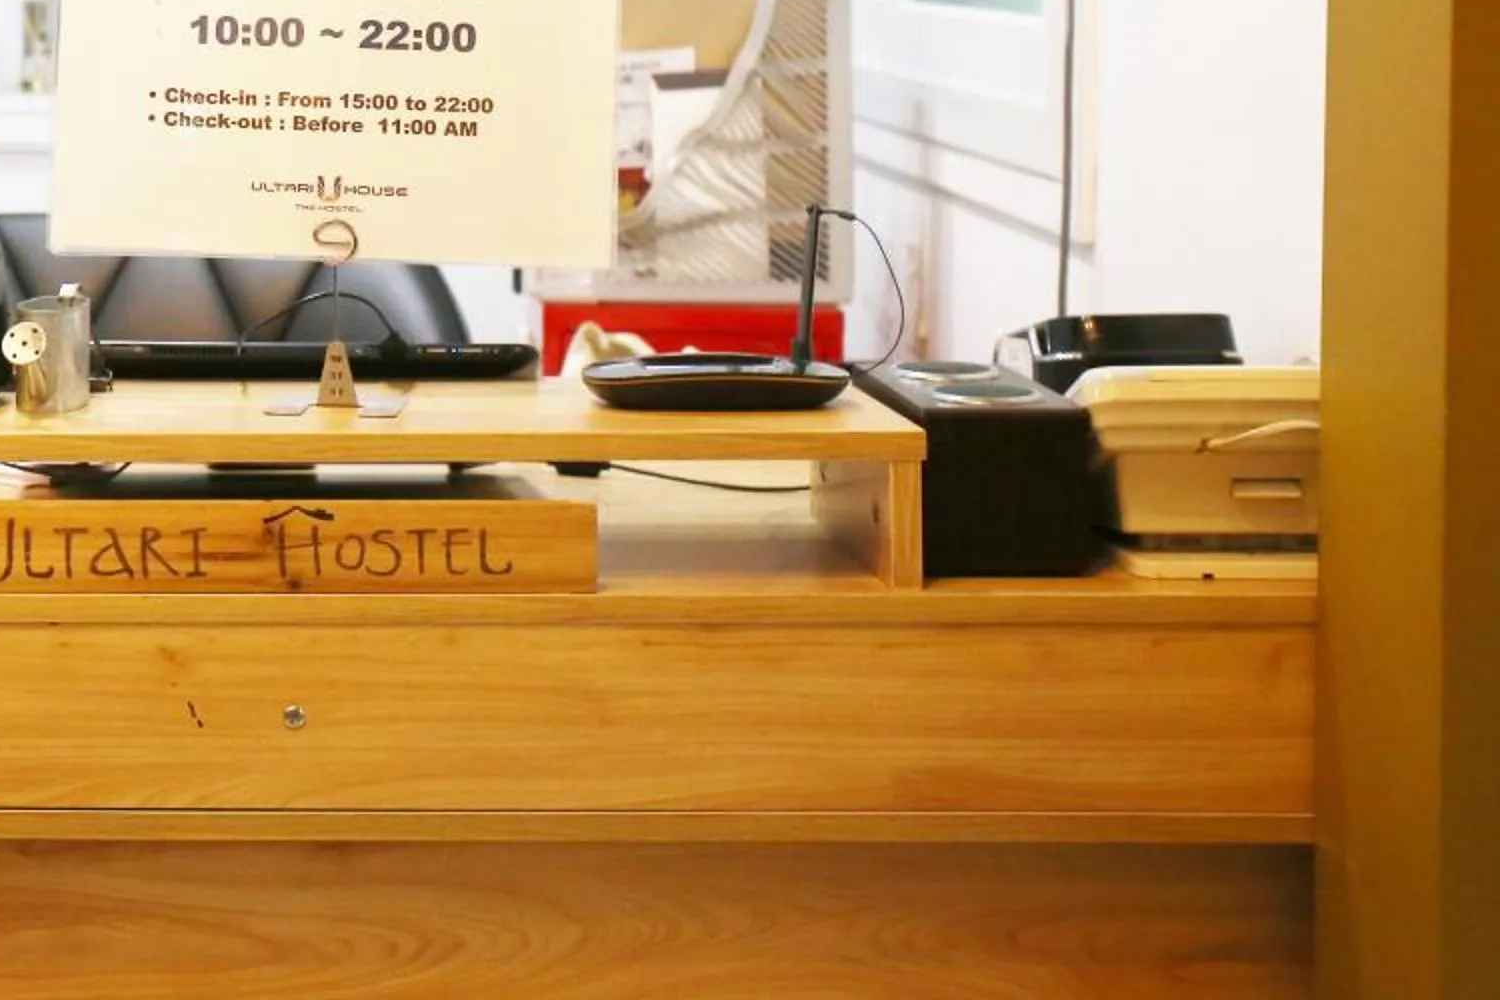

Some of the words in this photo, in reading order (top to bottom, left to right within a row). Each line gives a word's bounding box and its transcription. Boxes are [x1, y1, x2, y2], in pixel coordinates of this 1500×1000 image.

[190, 15, 305, 48] 10:00
[319, 27, 344, 39] ~
[359, 19, 477, 53] 22:00
[164, 88, 257, 106] Check-in
[278, 92, 332, 109] From
[340, 94, 399, 111] 15:00
[405, 95, 427, 111] to
[434, 97, 494, 114] 22:00
[163, 111, 273, 130] Check-out
[293, 116, 364, 133] Before
[377, 119, 437, 135] 11:00
[443, 121, 478, 137] AM
[251, 182, 315, 193] ULTARI
[344, 186, 409, 197] HOUSE
